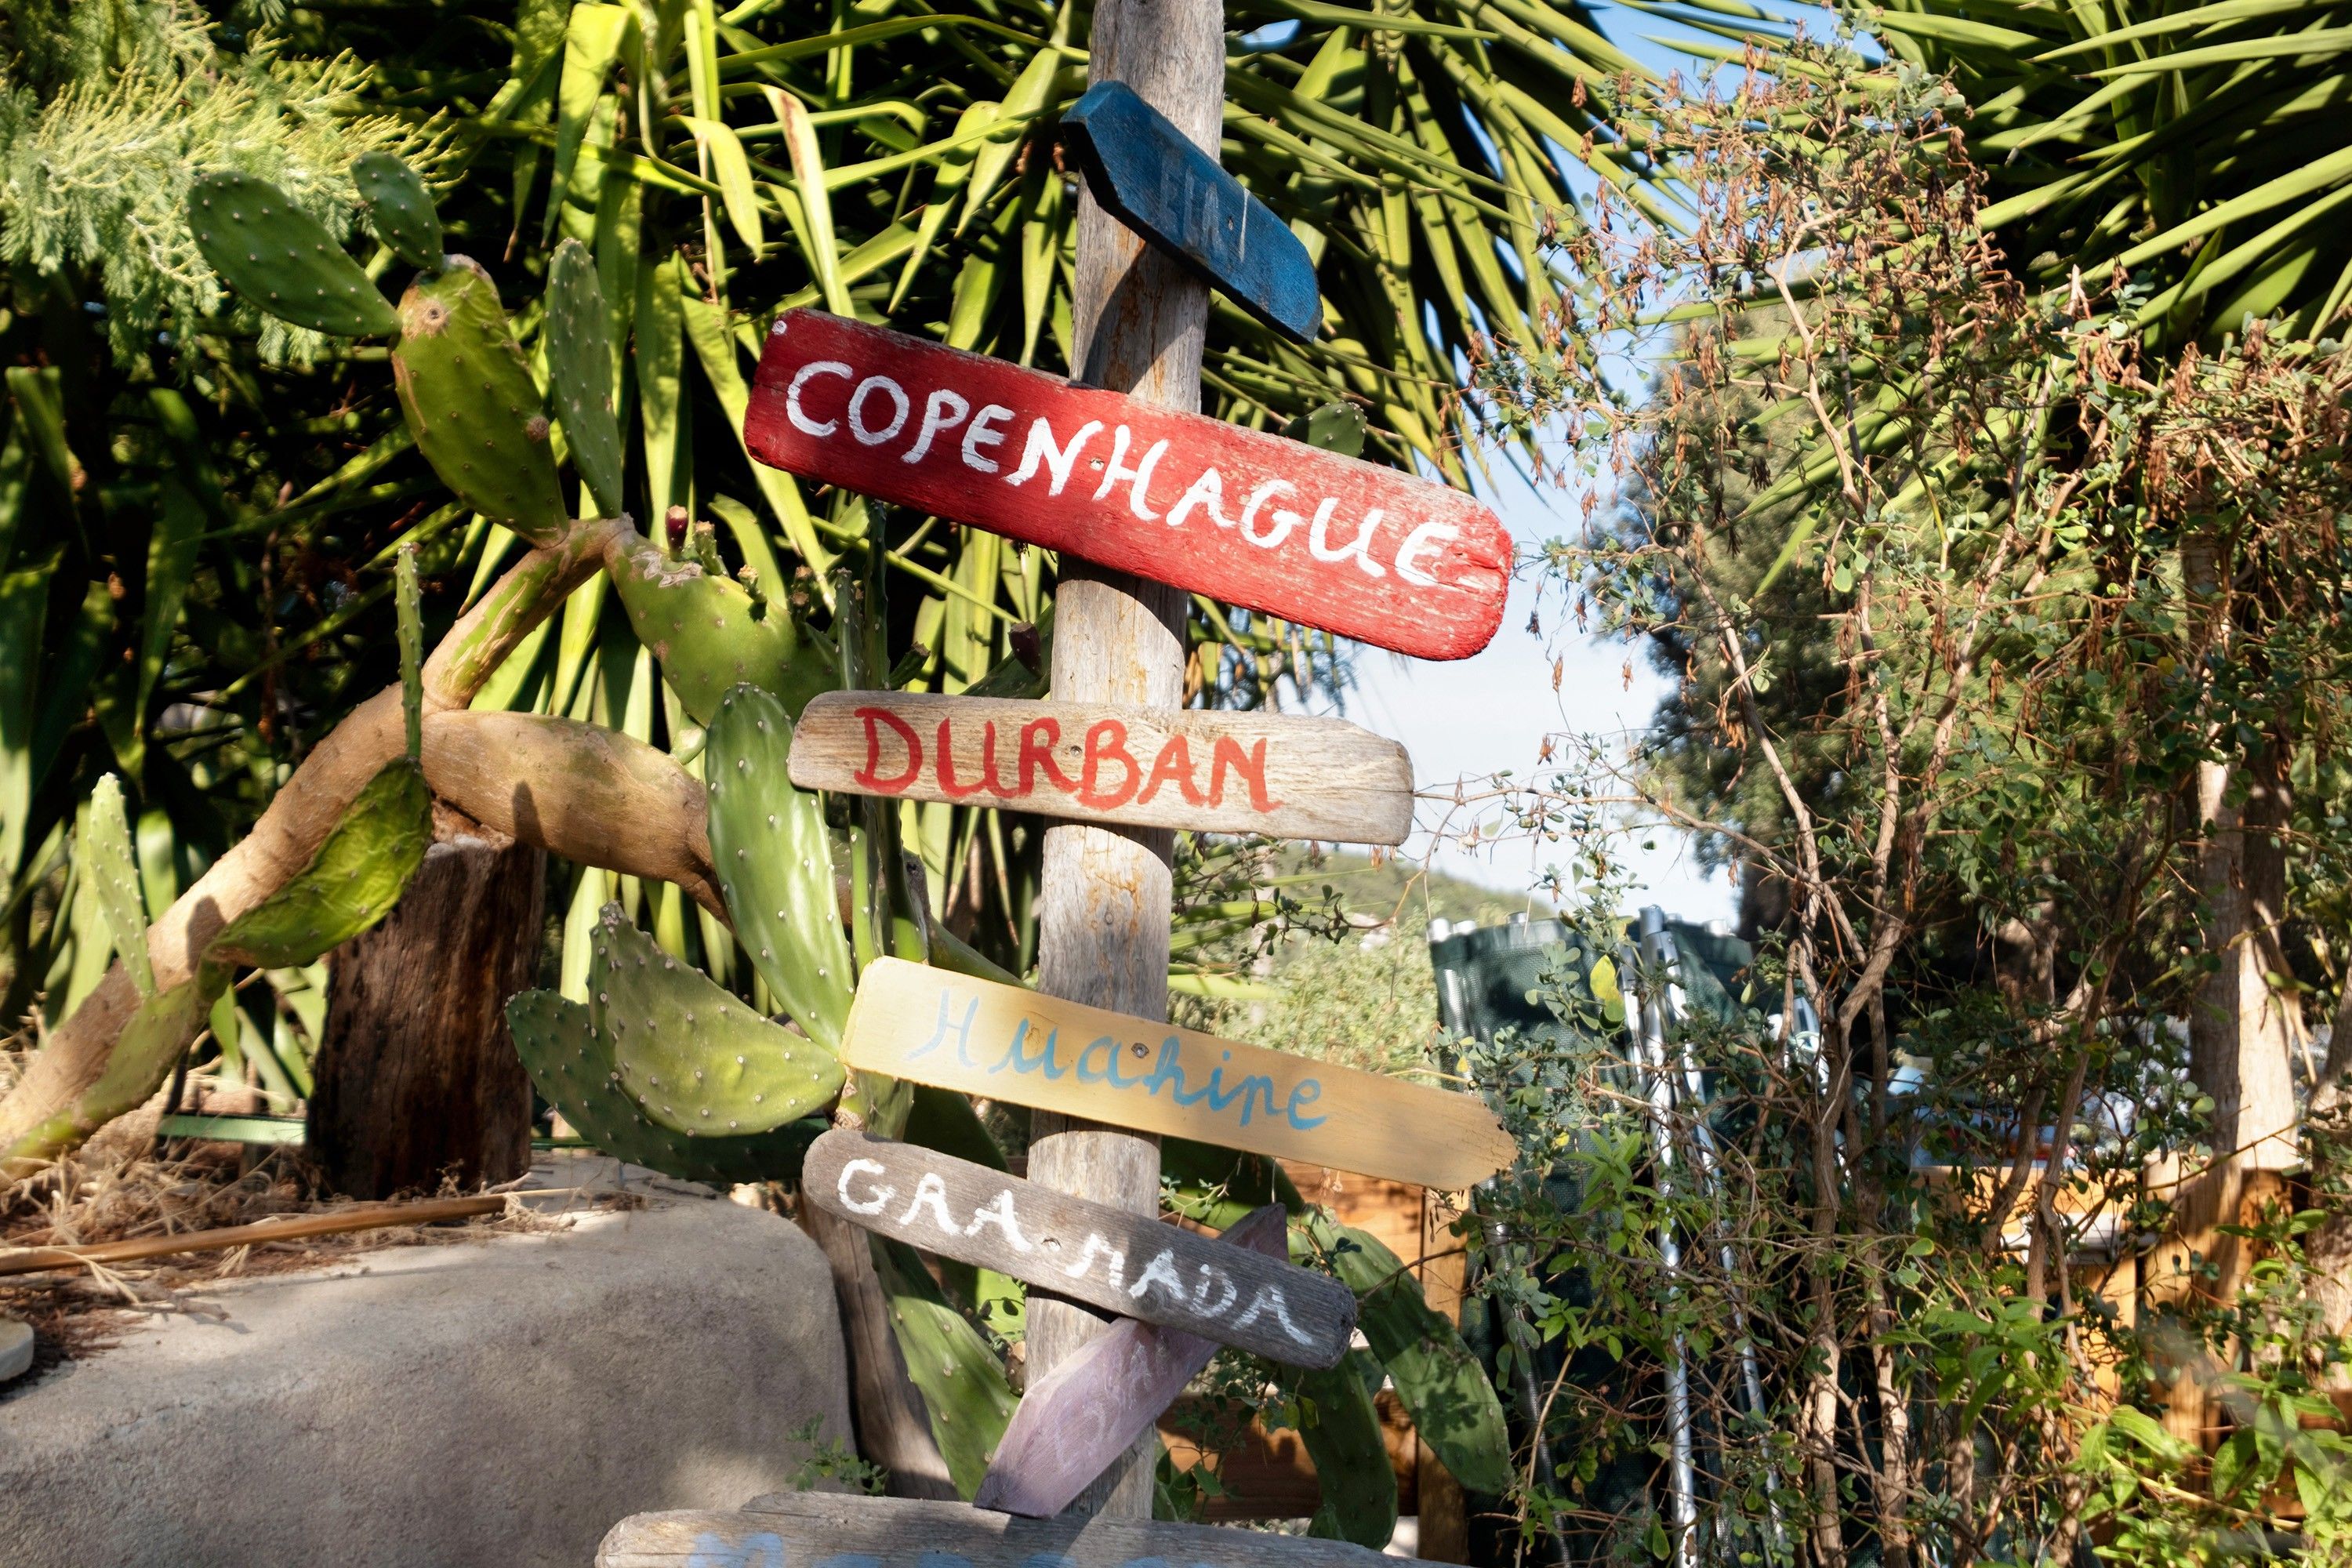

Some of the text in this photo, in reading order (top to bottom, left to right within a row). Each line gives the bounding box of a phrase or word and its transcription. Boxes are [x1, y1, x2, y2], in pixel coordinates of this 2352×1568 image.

[786, 360, 1460, 586] COPENHAGUE
[854, 706, 1283, 813] DURBAN
[905, 988, 1328, 1131] Huahine
